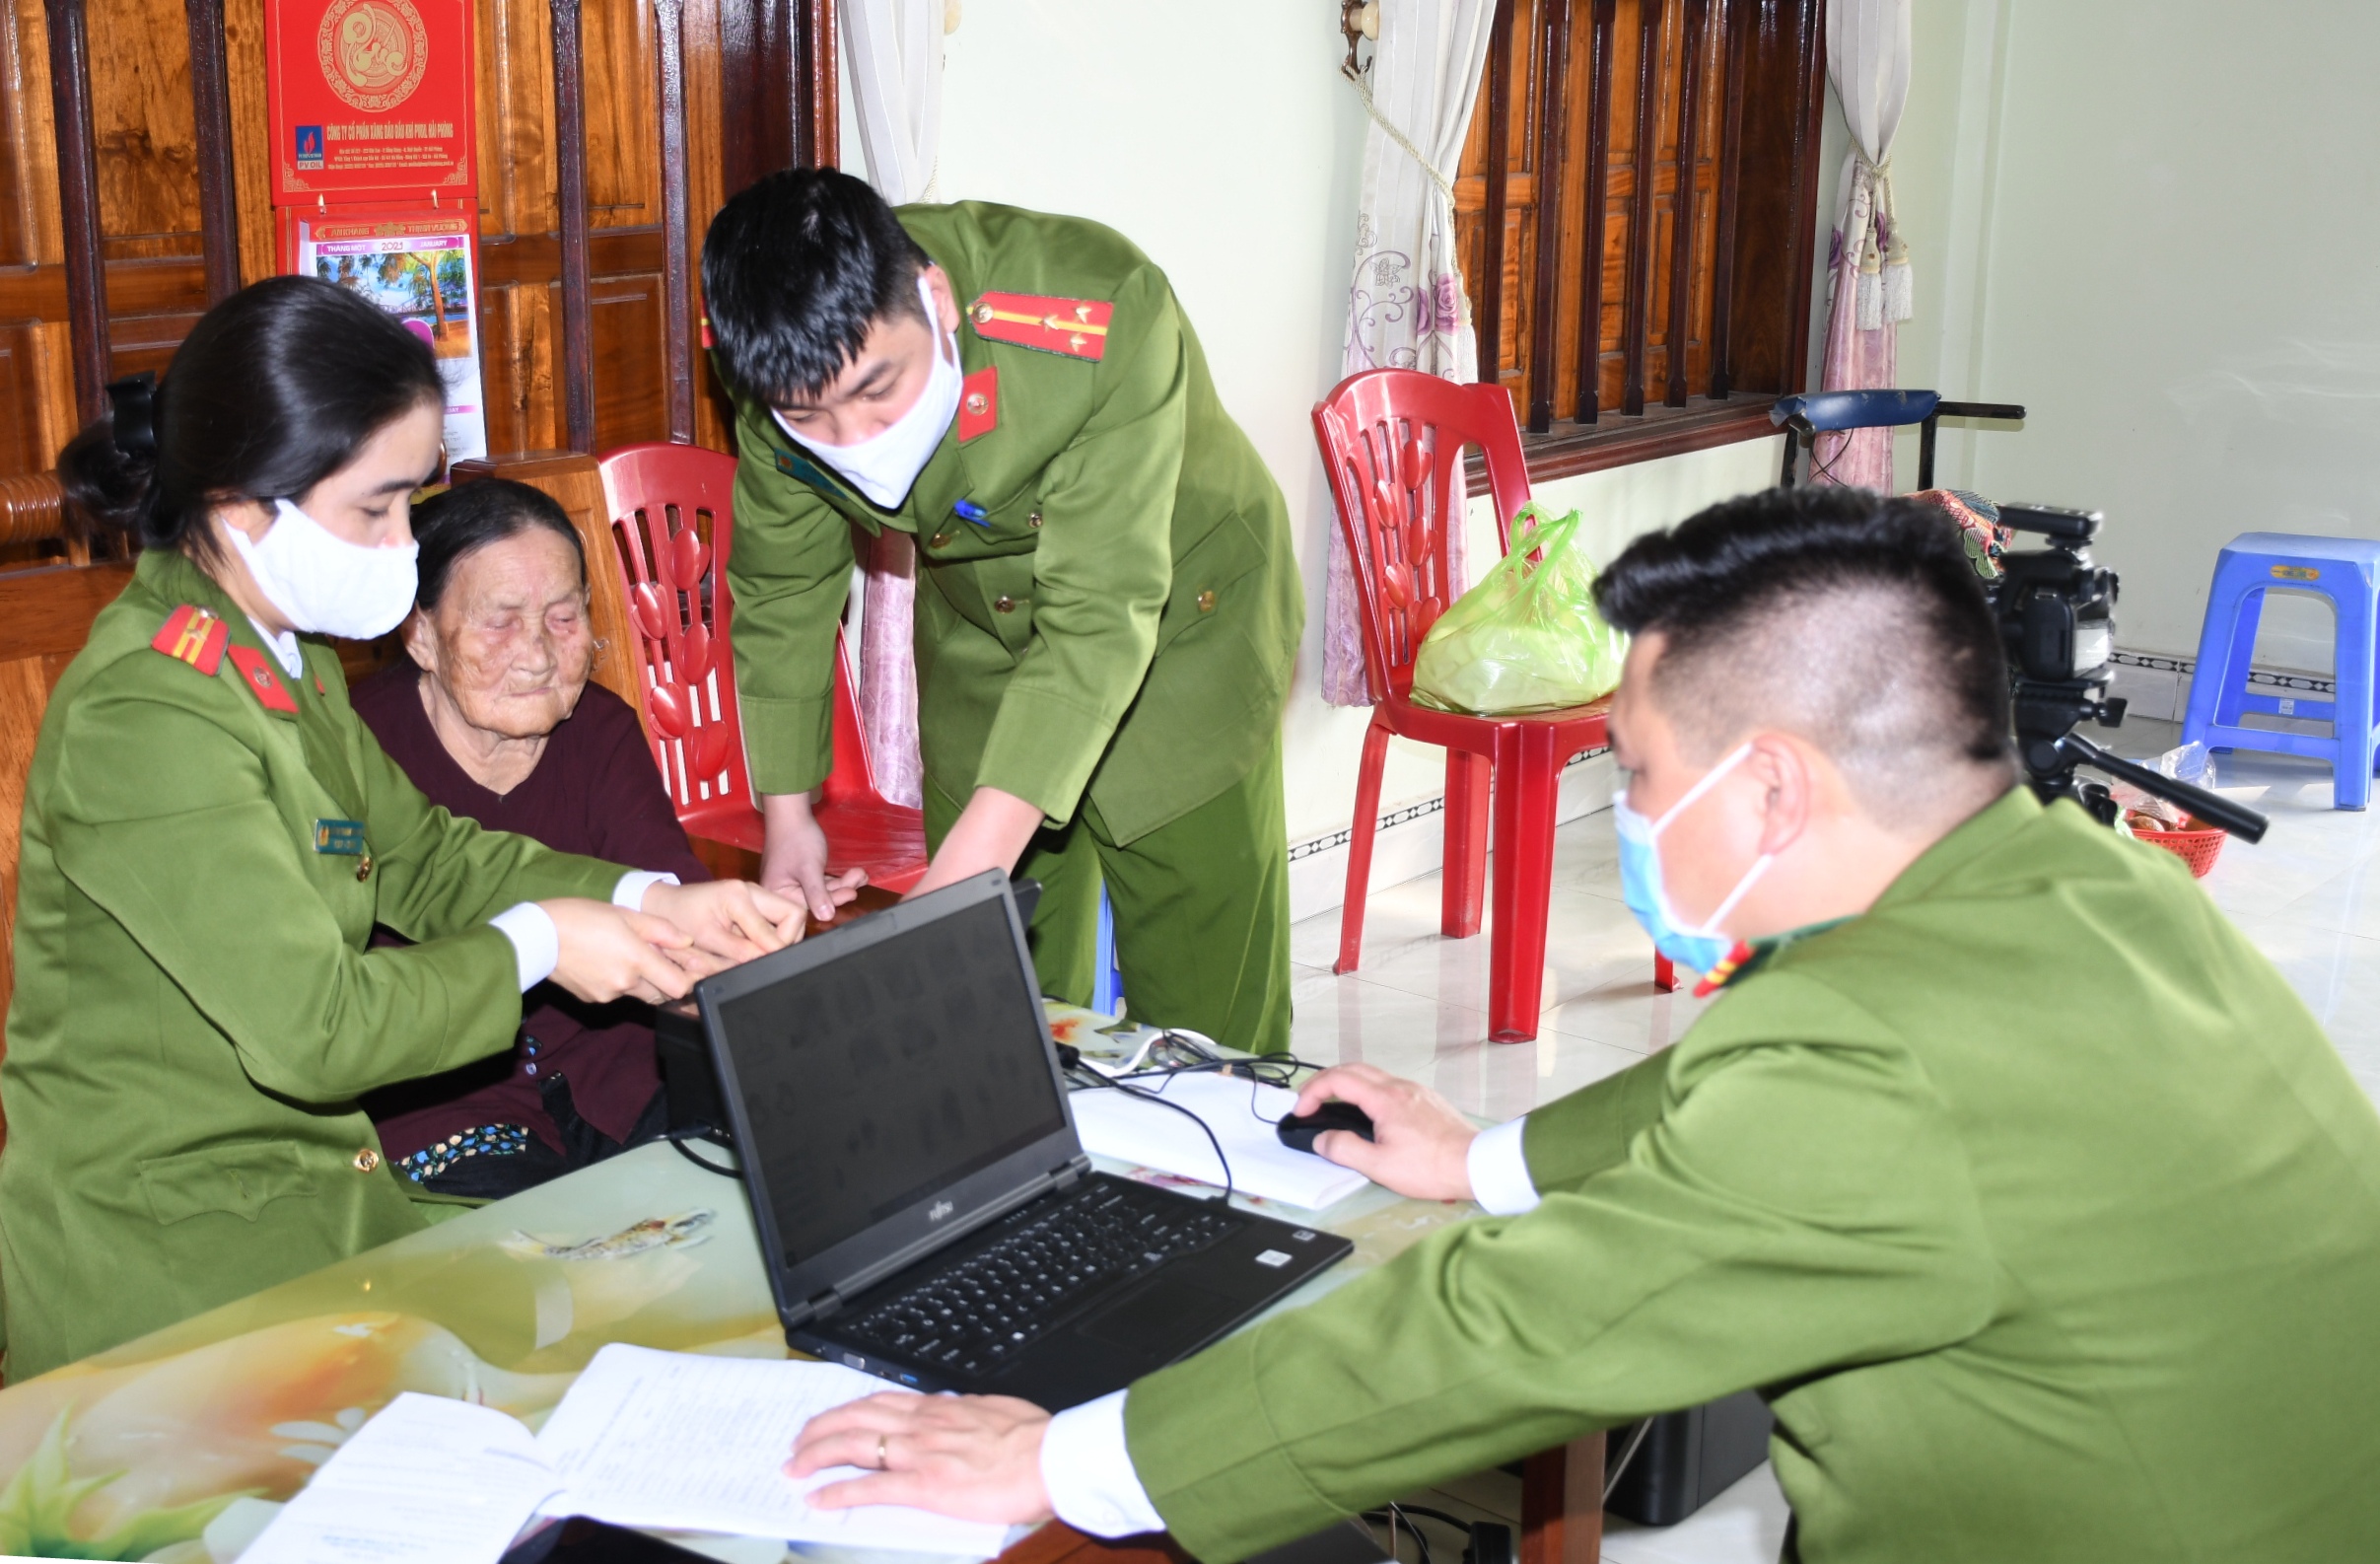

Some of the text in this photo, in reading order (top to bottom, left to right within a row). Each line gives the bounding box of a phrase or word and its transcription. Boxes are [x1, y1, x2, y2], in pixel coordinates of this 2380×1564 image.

[326, 122, 340, 140] CÔNG
[341, 125, 347, 140] TY
[382, 242, 403, 251] 2021
